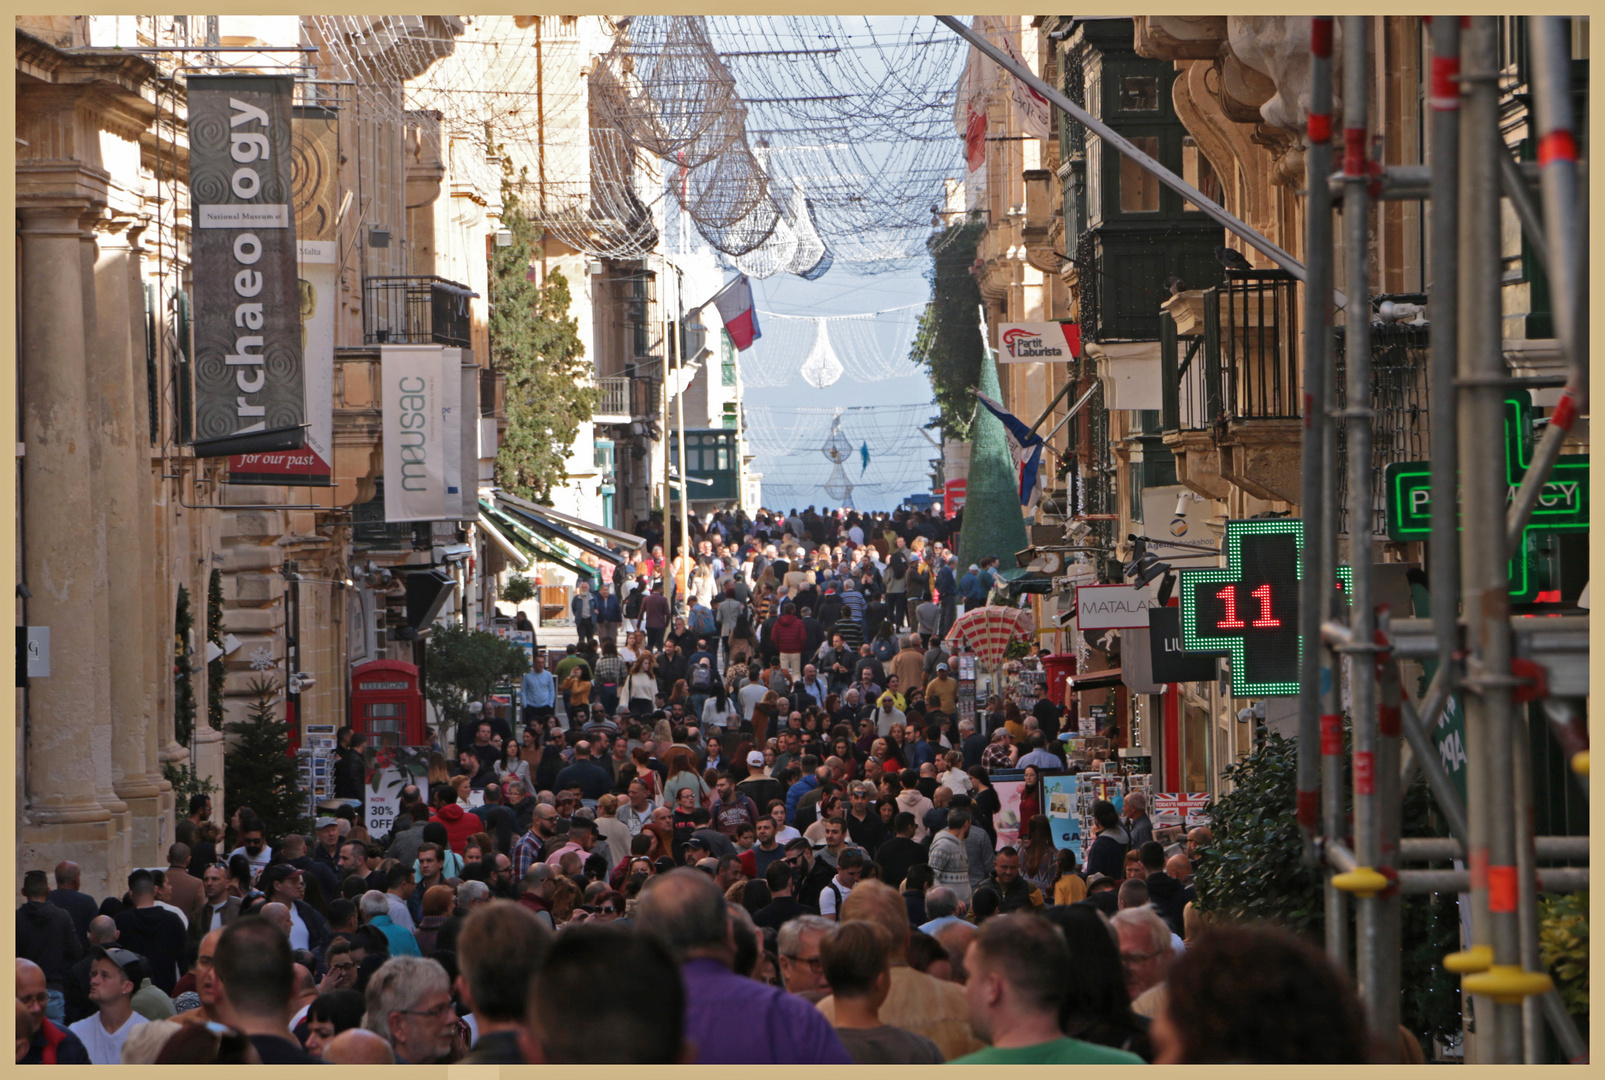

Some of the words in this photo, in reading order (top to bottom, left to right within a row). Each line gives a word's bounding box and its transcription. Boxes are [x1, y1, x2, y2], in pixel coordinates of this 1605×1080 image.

[206, 212, 240, 220] National
[242, 212, 273, 220] Museum
[1017, 338, 1042, 348] Partit
[1017, 347, 1062, 357] Laburista
[262, 455, 285, 465] our
[285, 454, 315, 469] past
[371, 806, 393, 816] 30%
[371, 819, 392, 829] OFF
